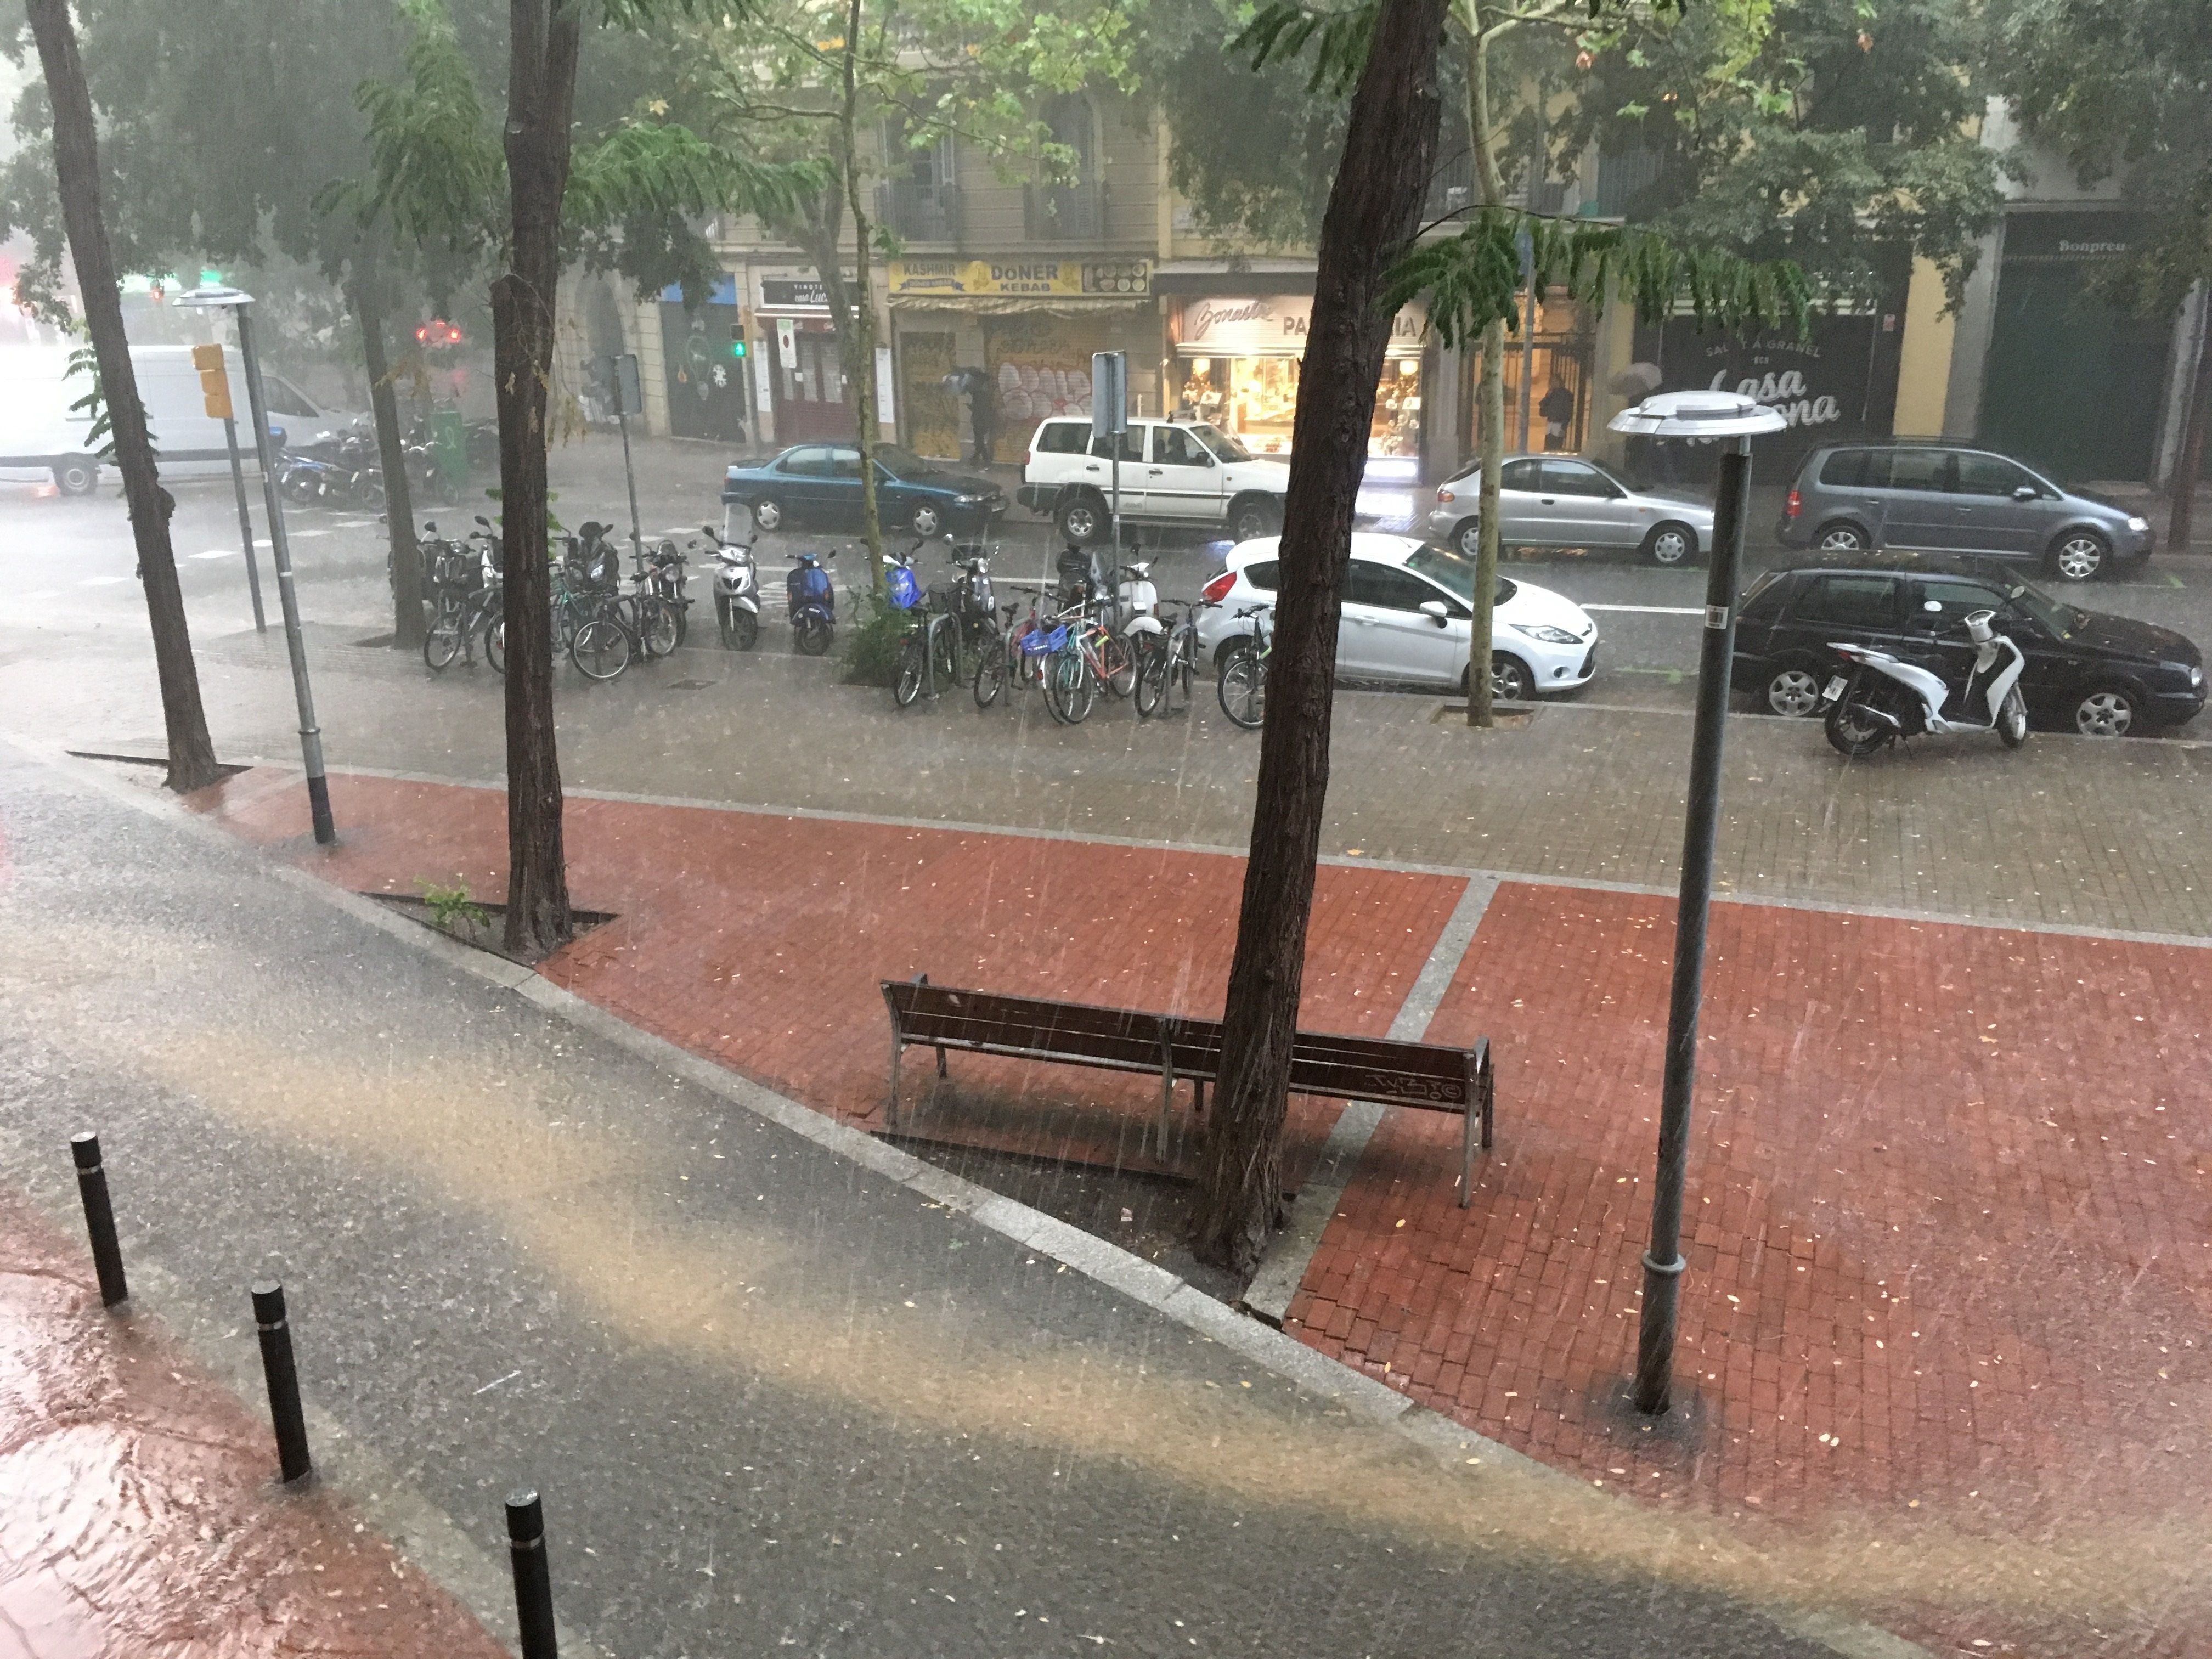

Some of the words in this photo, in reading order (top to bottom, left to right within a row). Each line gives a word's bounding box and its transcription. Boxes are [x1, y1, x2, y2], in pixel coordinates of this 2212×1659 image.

[903, 263, 956, 275] KASHMIR
[1000, 283, 1051, 292] KEBAB
[810, 290, 828, 303] Luc
